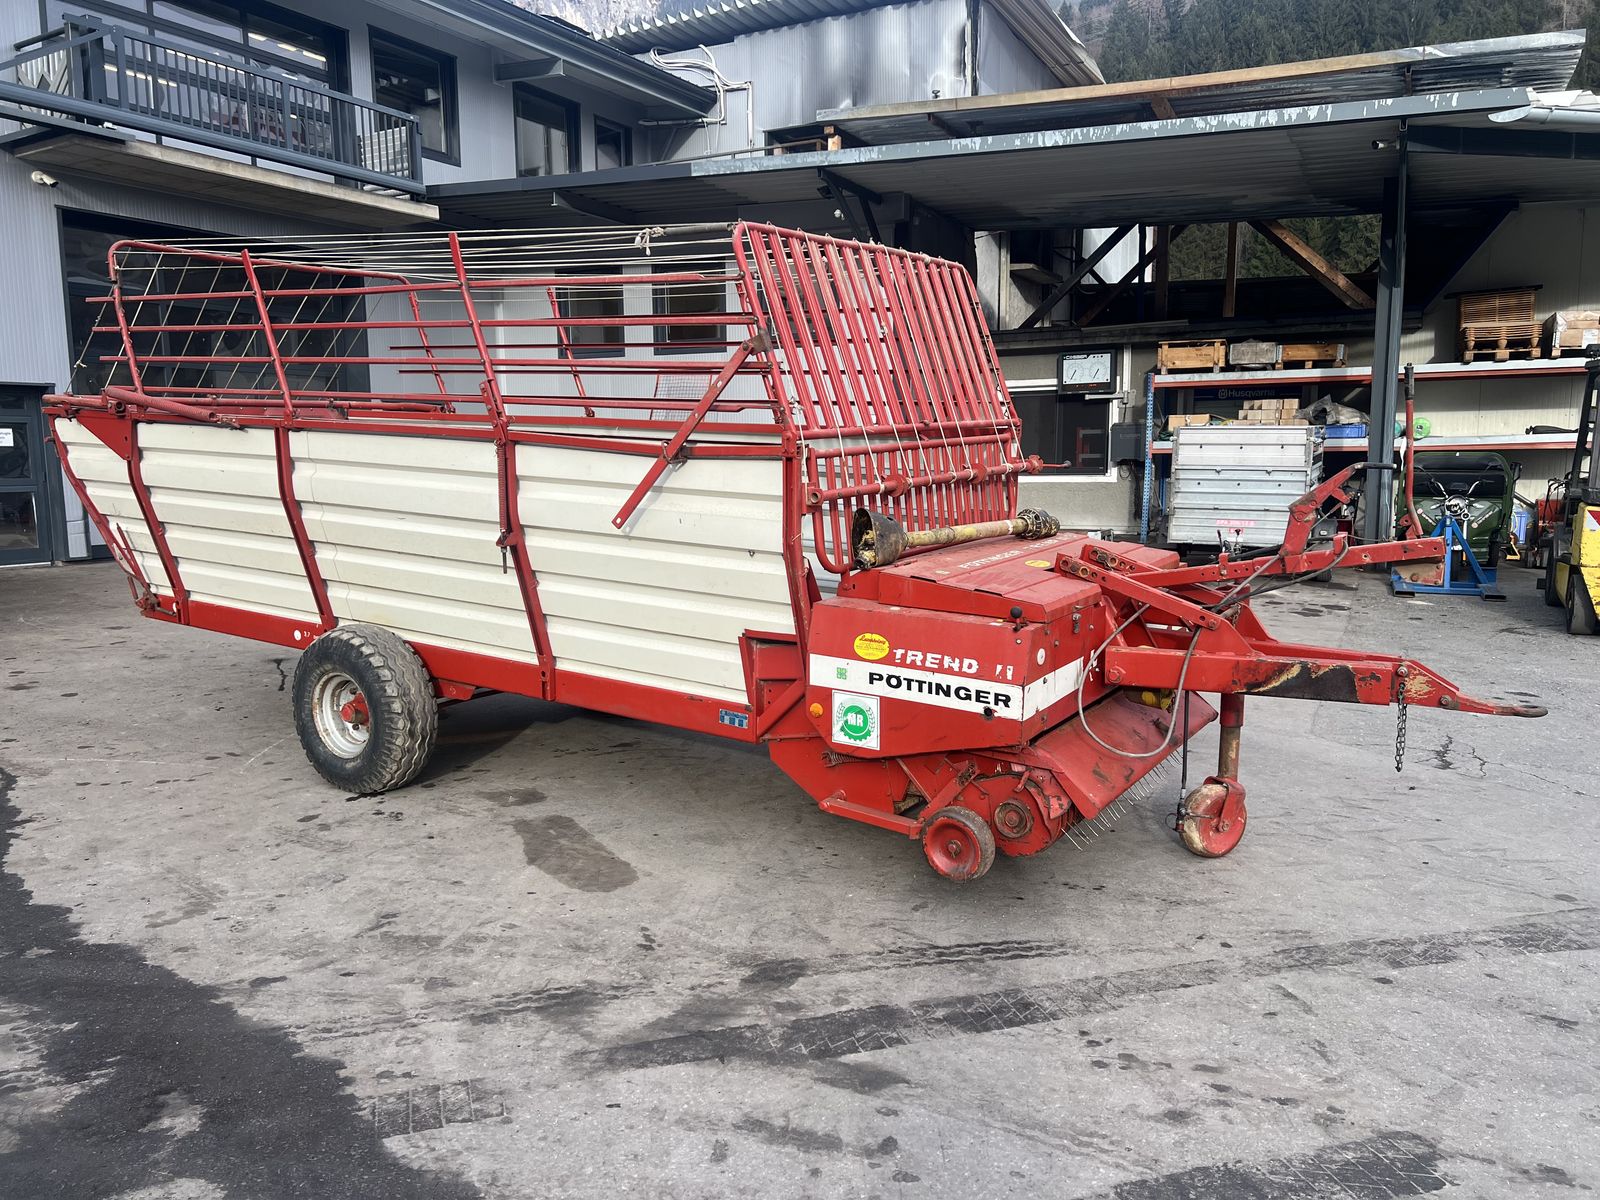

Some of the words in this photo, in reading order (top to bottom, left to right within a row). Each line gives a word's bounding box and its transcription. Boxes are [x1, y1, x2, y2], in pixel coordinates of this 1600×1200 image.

[1228, 389, 1275, 399] Husqvarna
[893, 648, 979, 675] TREND
[868, 671, 1012, 709] PÖTTINGER
